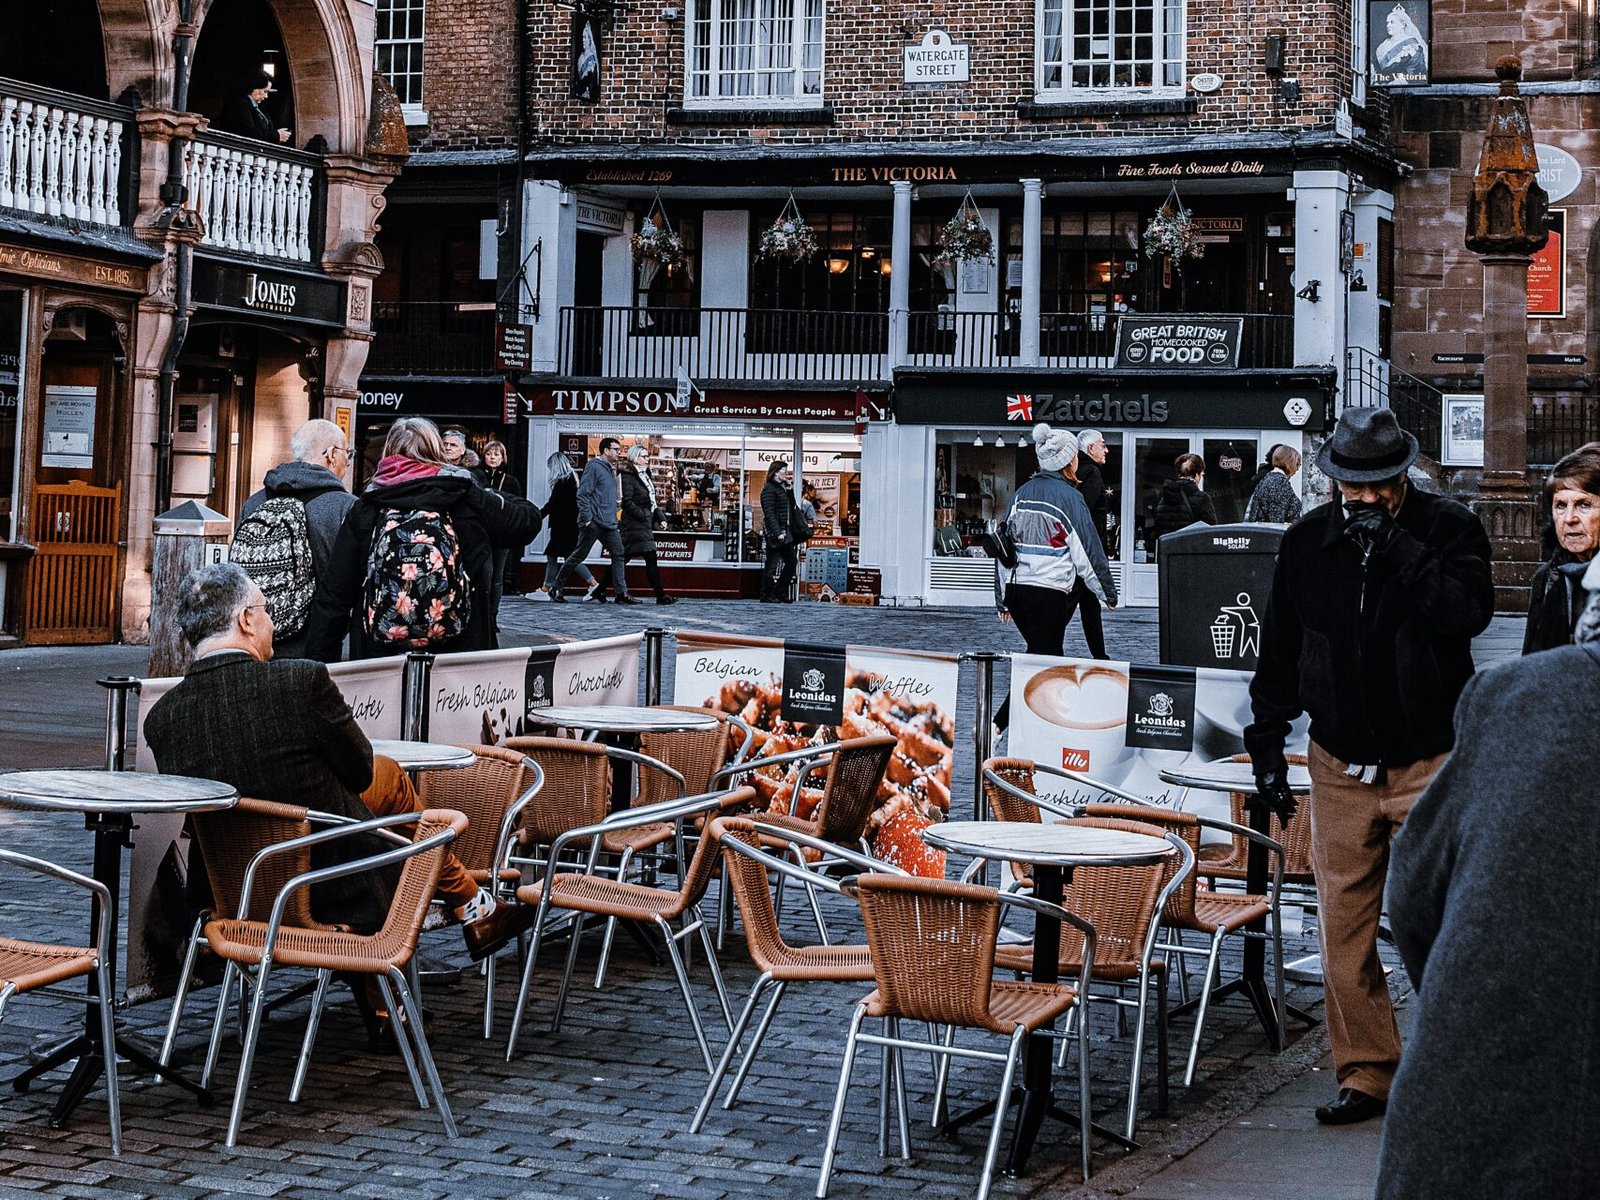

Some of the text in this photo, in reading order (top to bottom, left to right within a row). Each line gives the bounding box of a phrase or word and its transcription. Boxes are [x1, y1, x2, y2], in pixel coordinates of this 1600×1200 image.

[908, 50, 966, 62] WATERGATE
[916, 64, 956, 76] STREET
[1375, 72, 1427, 81] The Victoria
[1550, 156, 1566, 164] Lord
[586, 169, 673, 181] Established 1269
[832, 166, 957, 181] THE VICTORIA
[1117, 160, 1264, 176] Fine Foods Served Daily
[1536, 169, 1562, 182] RIST
[578, 205, 623, 226] THE VICTORIA
[1195, 220, 1240, 229] ICTORIA
[20, 251, 61, 272] Opticians
[114, 269, 130, 285] 1815
[1528, 264, 1552, 272] Church
[244, 273, 297, 306] JONES
[1131, 325, 1227, 341] GREAT BRITISH
[1151, 339, 1208, 348] HOMECOOKED
[1150, 347, 1205, 363] FOOD
[551, 390, 680, 413] TIMPSON
[1036, 394, 1168, 422] Zatchels
[694, 406, 720, 414] Great
[722, 406, 758, 415] Service
[761, 407, 773, 416] By
[775, 407, 801, 415] Great
[804, 408, 836, 416] People
[758, 452, 818, 465] Key Cuing
[821, 477, 836, 487] KEY
[654, 541, 688, 549] DITIONAL
[1213, 537, 1250, 546] BigBelly
[214, 549, 221, 564] P
[694, 657, 934, 698] Belgian Waffles
[435, 667, 624, 712] Fresh Belgian Chocolates
[789, 688, 837, 703] Leonidas
[351, 694, 384, 721] lates
[528, 698, 551, 709] Leonidas
[1135, 713, 1186, 728] Leonidas
[1063, 752, 1088, 768] illy
[1035, 789, 1091, 808] reshly
